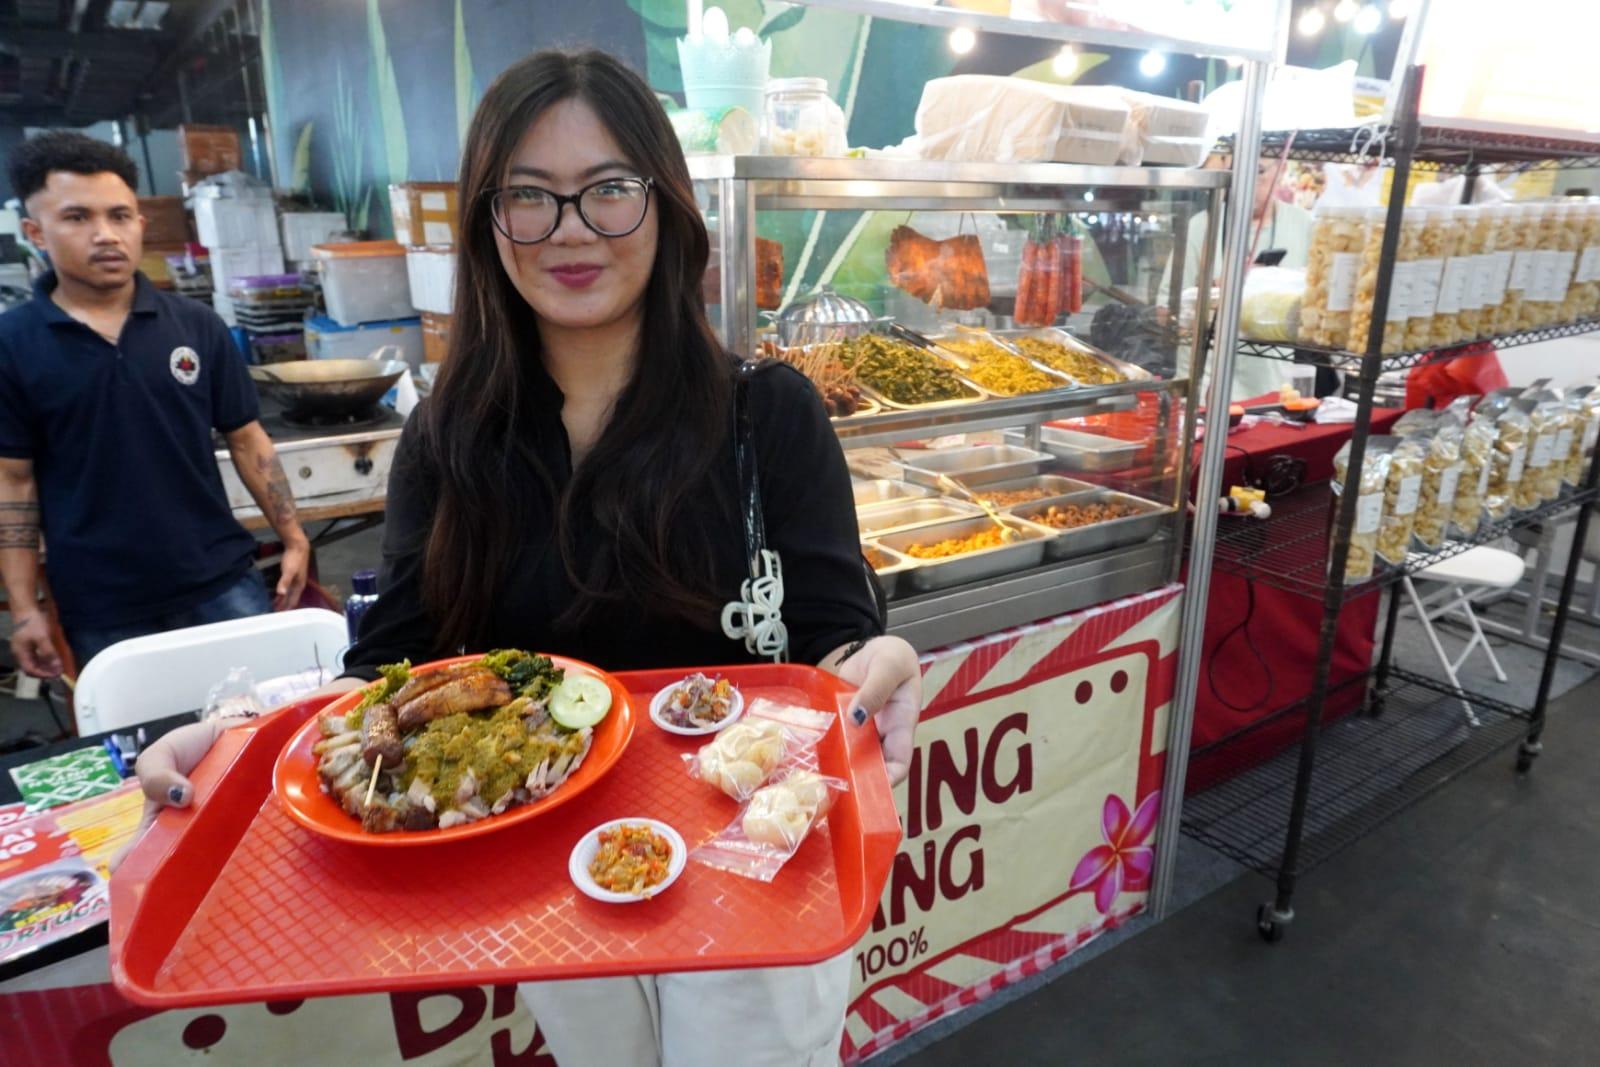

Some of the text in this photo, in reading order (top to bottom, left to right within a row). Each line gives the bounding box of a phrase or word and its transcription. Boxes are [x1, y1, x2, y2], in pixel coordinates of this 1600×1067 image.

[906, 712, 1032, 839] ING
[872, 824, 984, 933] NG
[856, 926, 928, 982] 100%
